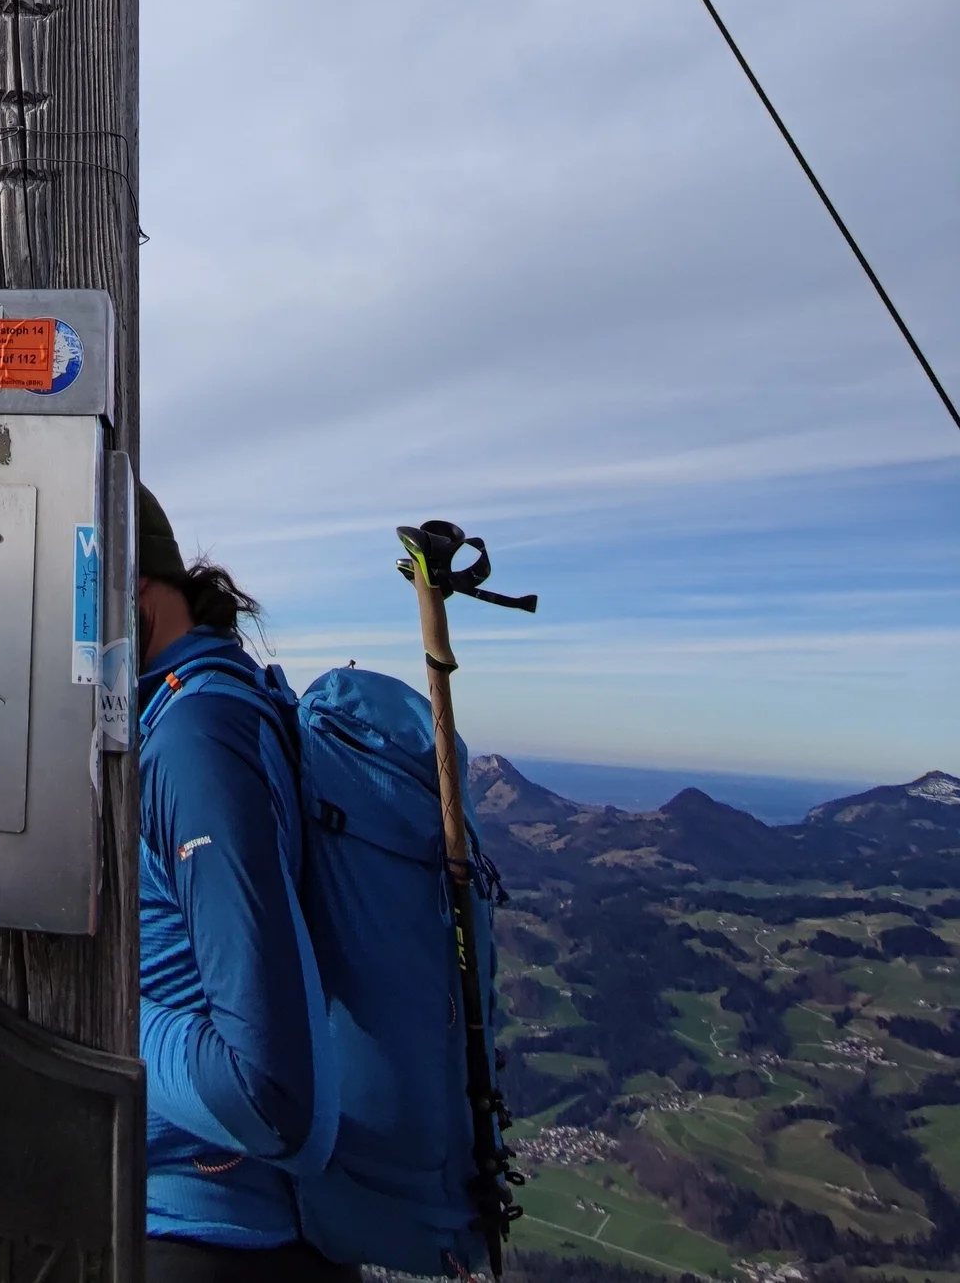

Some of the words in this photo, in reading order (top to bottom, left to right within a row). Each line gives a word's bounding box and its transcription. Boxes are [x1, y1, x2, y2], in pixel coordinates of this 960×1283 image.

[32, 326, 44, 335] 14
[17, 354, 37, 364] 112
[454, 907, 467, 971] LEKI
